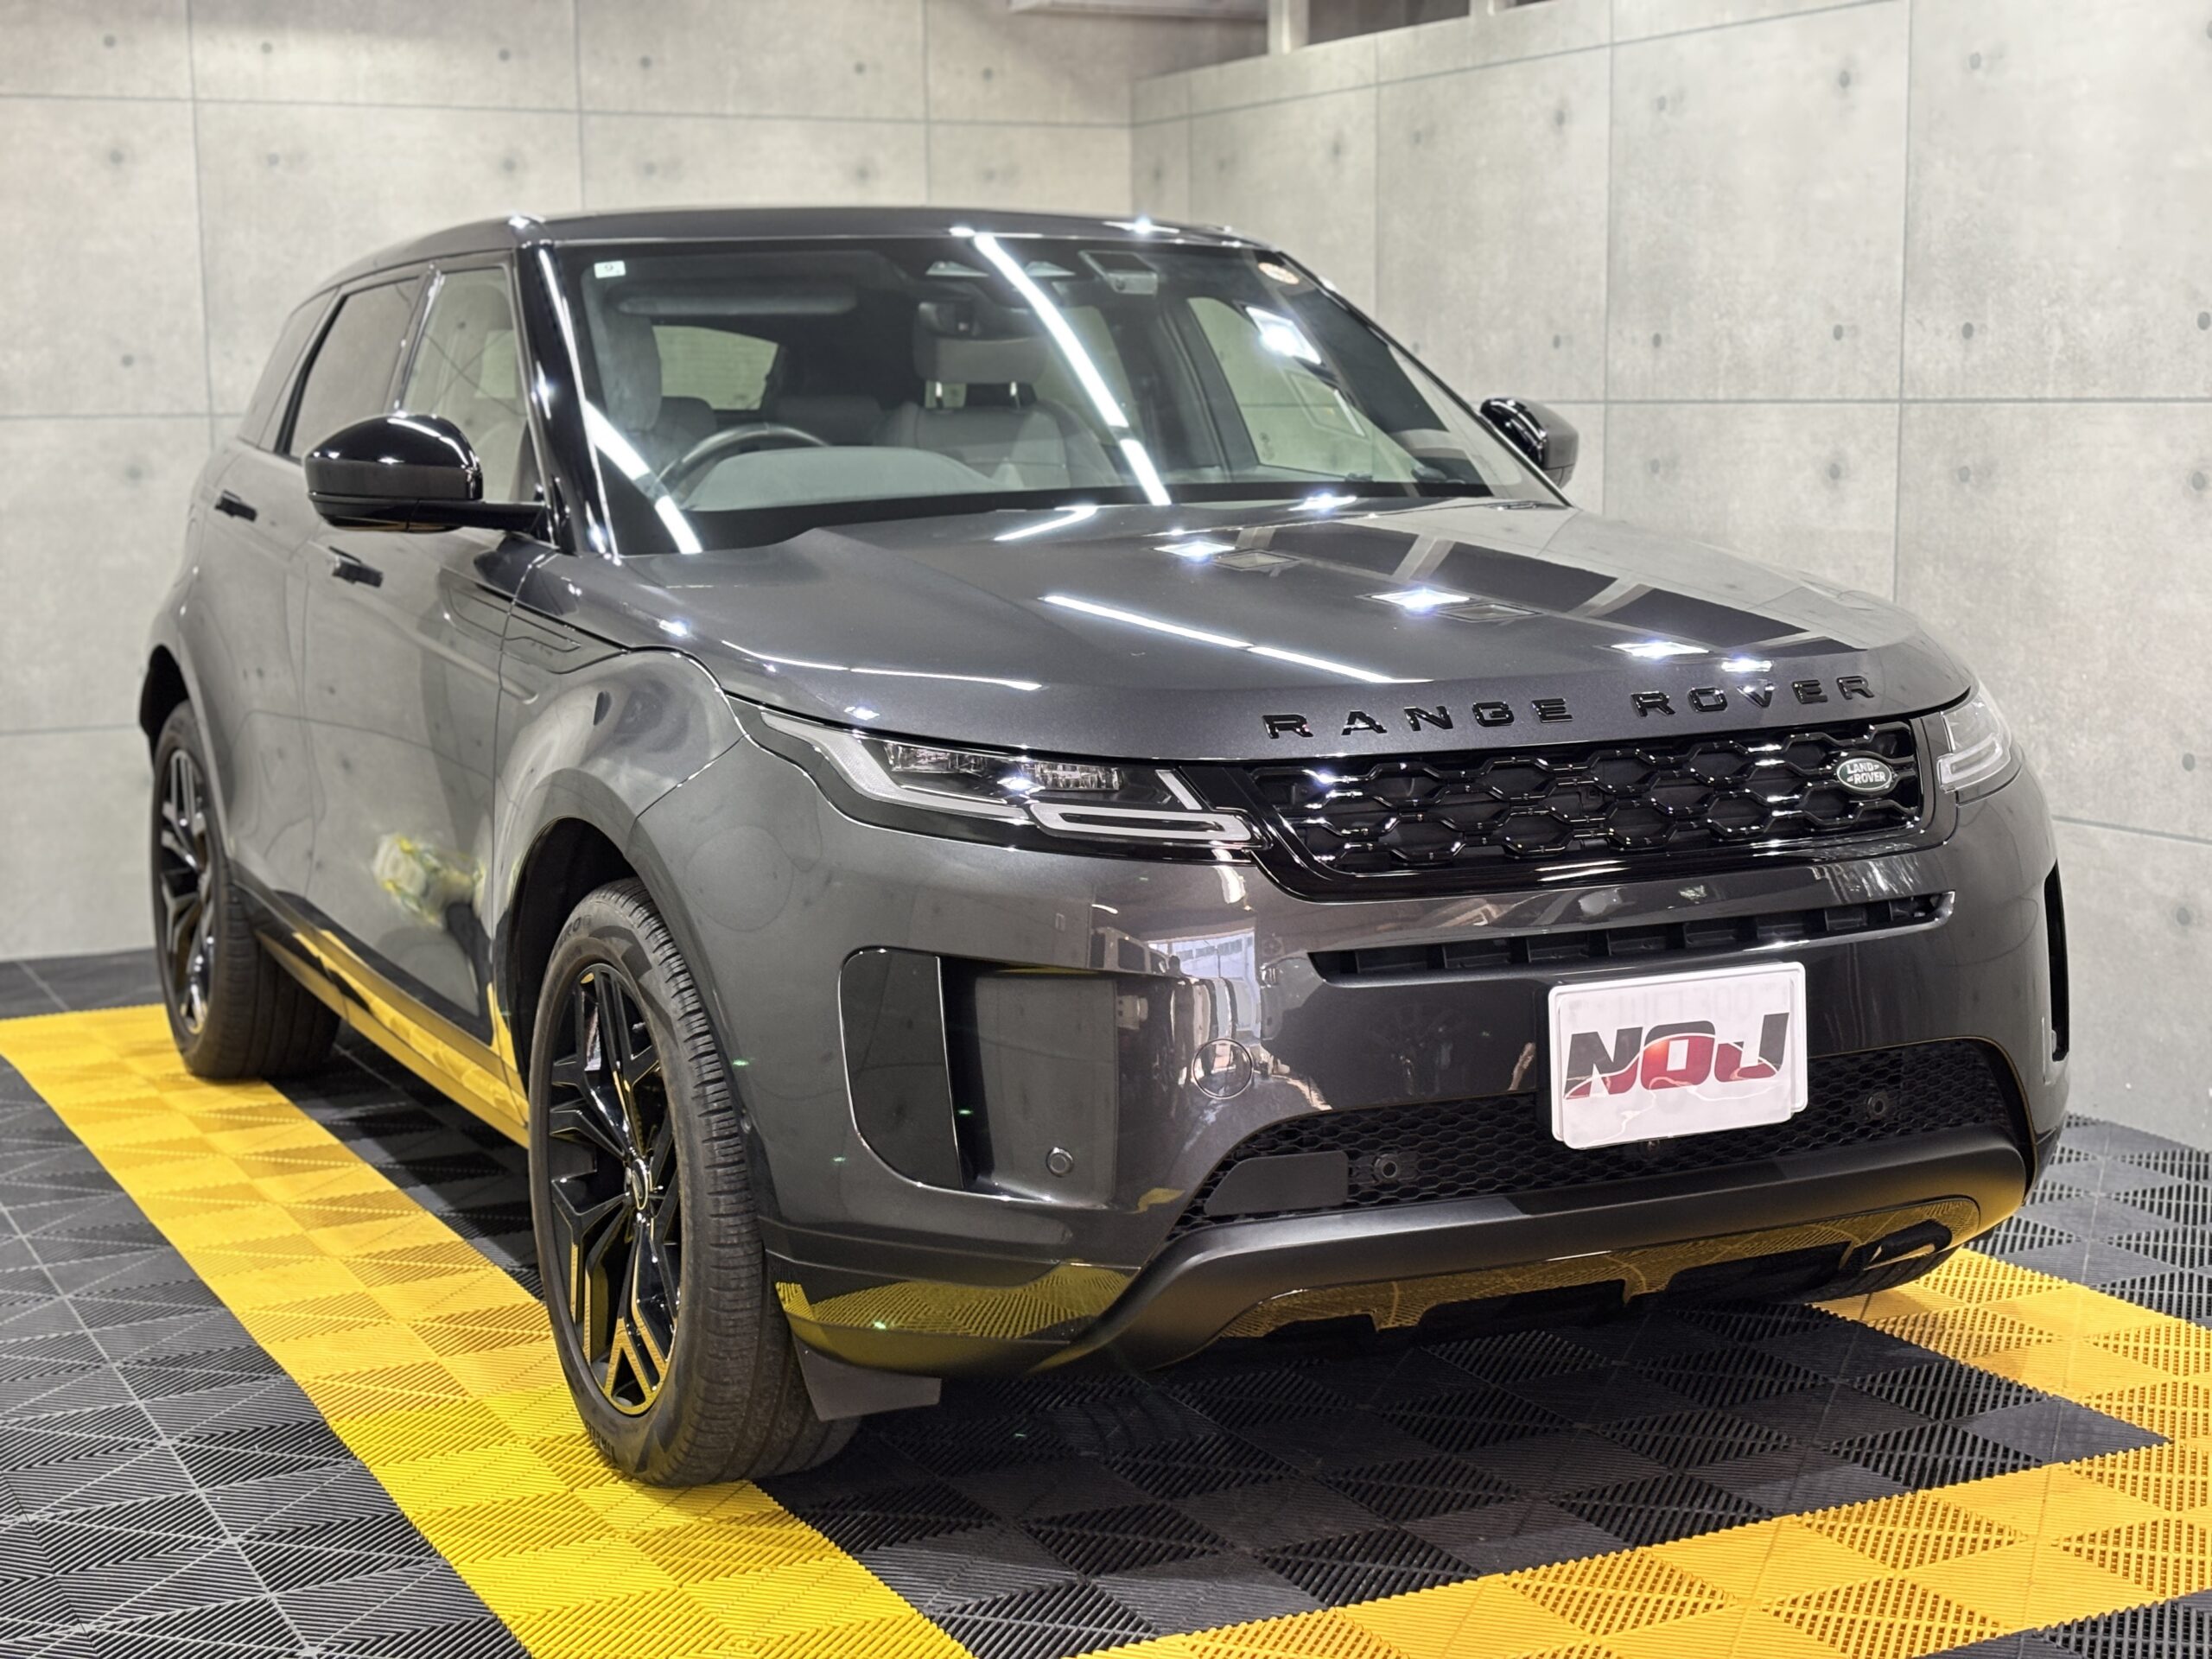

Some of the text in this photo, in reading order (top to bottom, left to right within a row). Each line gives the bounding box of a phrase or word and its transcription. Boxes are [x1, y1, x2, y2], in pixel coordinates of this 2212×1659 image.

[1261, 675, 1875, 739] RANGE ROVER
[1846, 762, 1875, 774] LAND
[1853, 771, 1886, 785] ROVER
